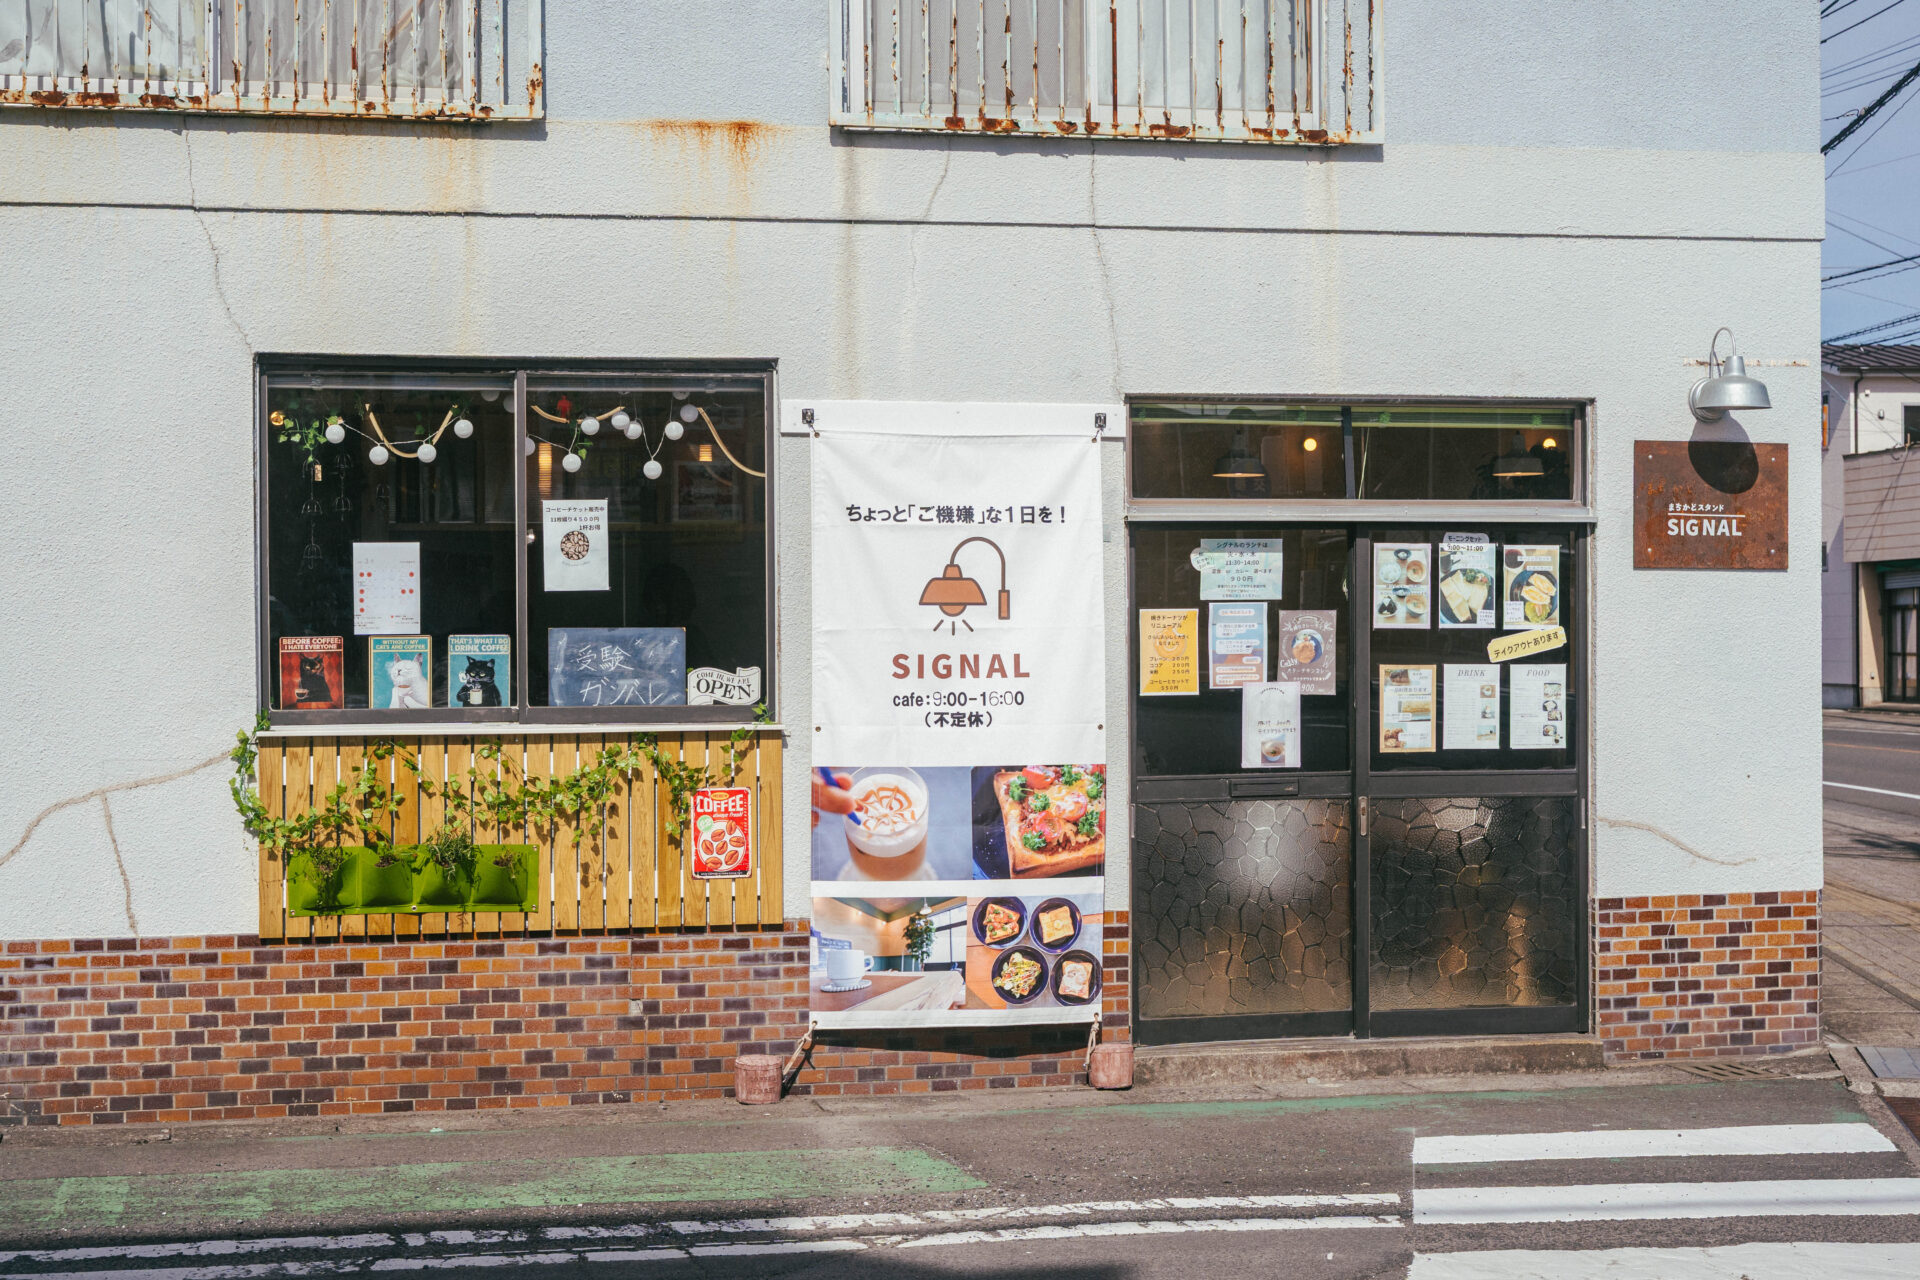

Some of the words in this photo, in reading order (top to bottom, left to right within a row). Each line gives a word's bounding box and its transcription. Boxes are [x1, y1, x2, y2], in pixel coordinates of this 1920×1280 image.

[1668, 503, 1725, 512] まちかどスタンド
[1667, 518, 1742, 537] SIGNAL
[311, 637, 341, 645] COFFEE:
[455, 644, 479, 652] DRINK
[481, 644, 509, 652] COFFEE
[1493, 631, 1560, 659] テイクアウトあります
[575, 644, 635, 672] 受験
[891, 653, 1031, 680] SIGNAL
[1457, 669, 1487, 677] DRINK
[1526, 669, 1551, 677] FOOD
[579, 676, 665, 706] ガンバレ
[696, 678, 752, 700] OPEN
[923, 711, 994, 728] （不定休）
[696, 794, 744, 813] COFFEE
